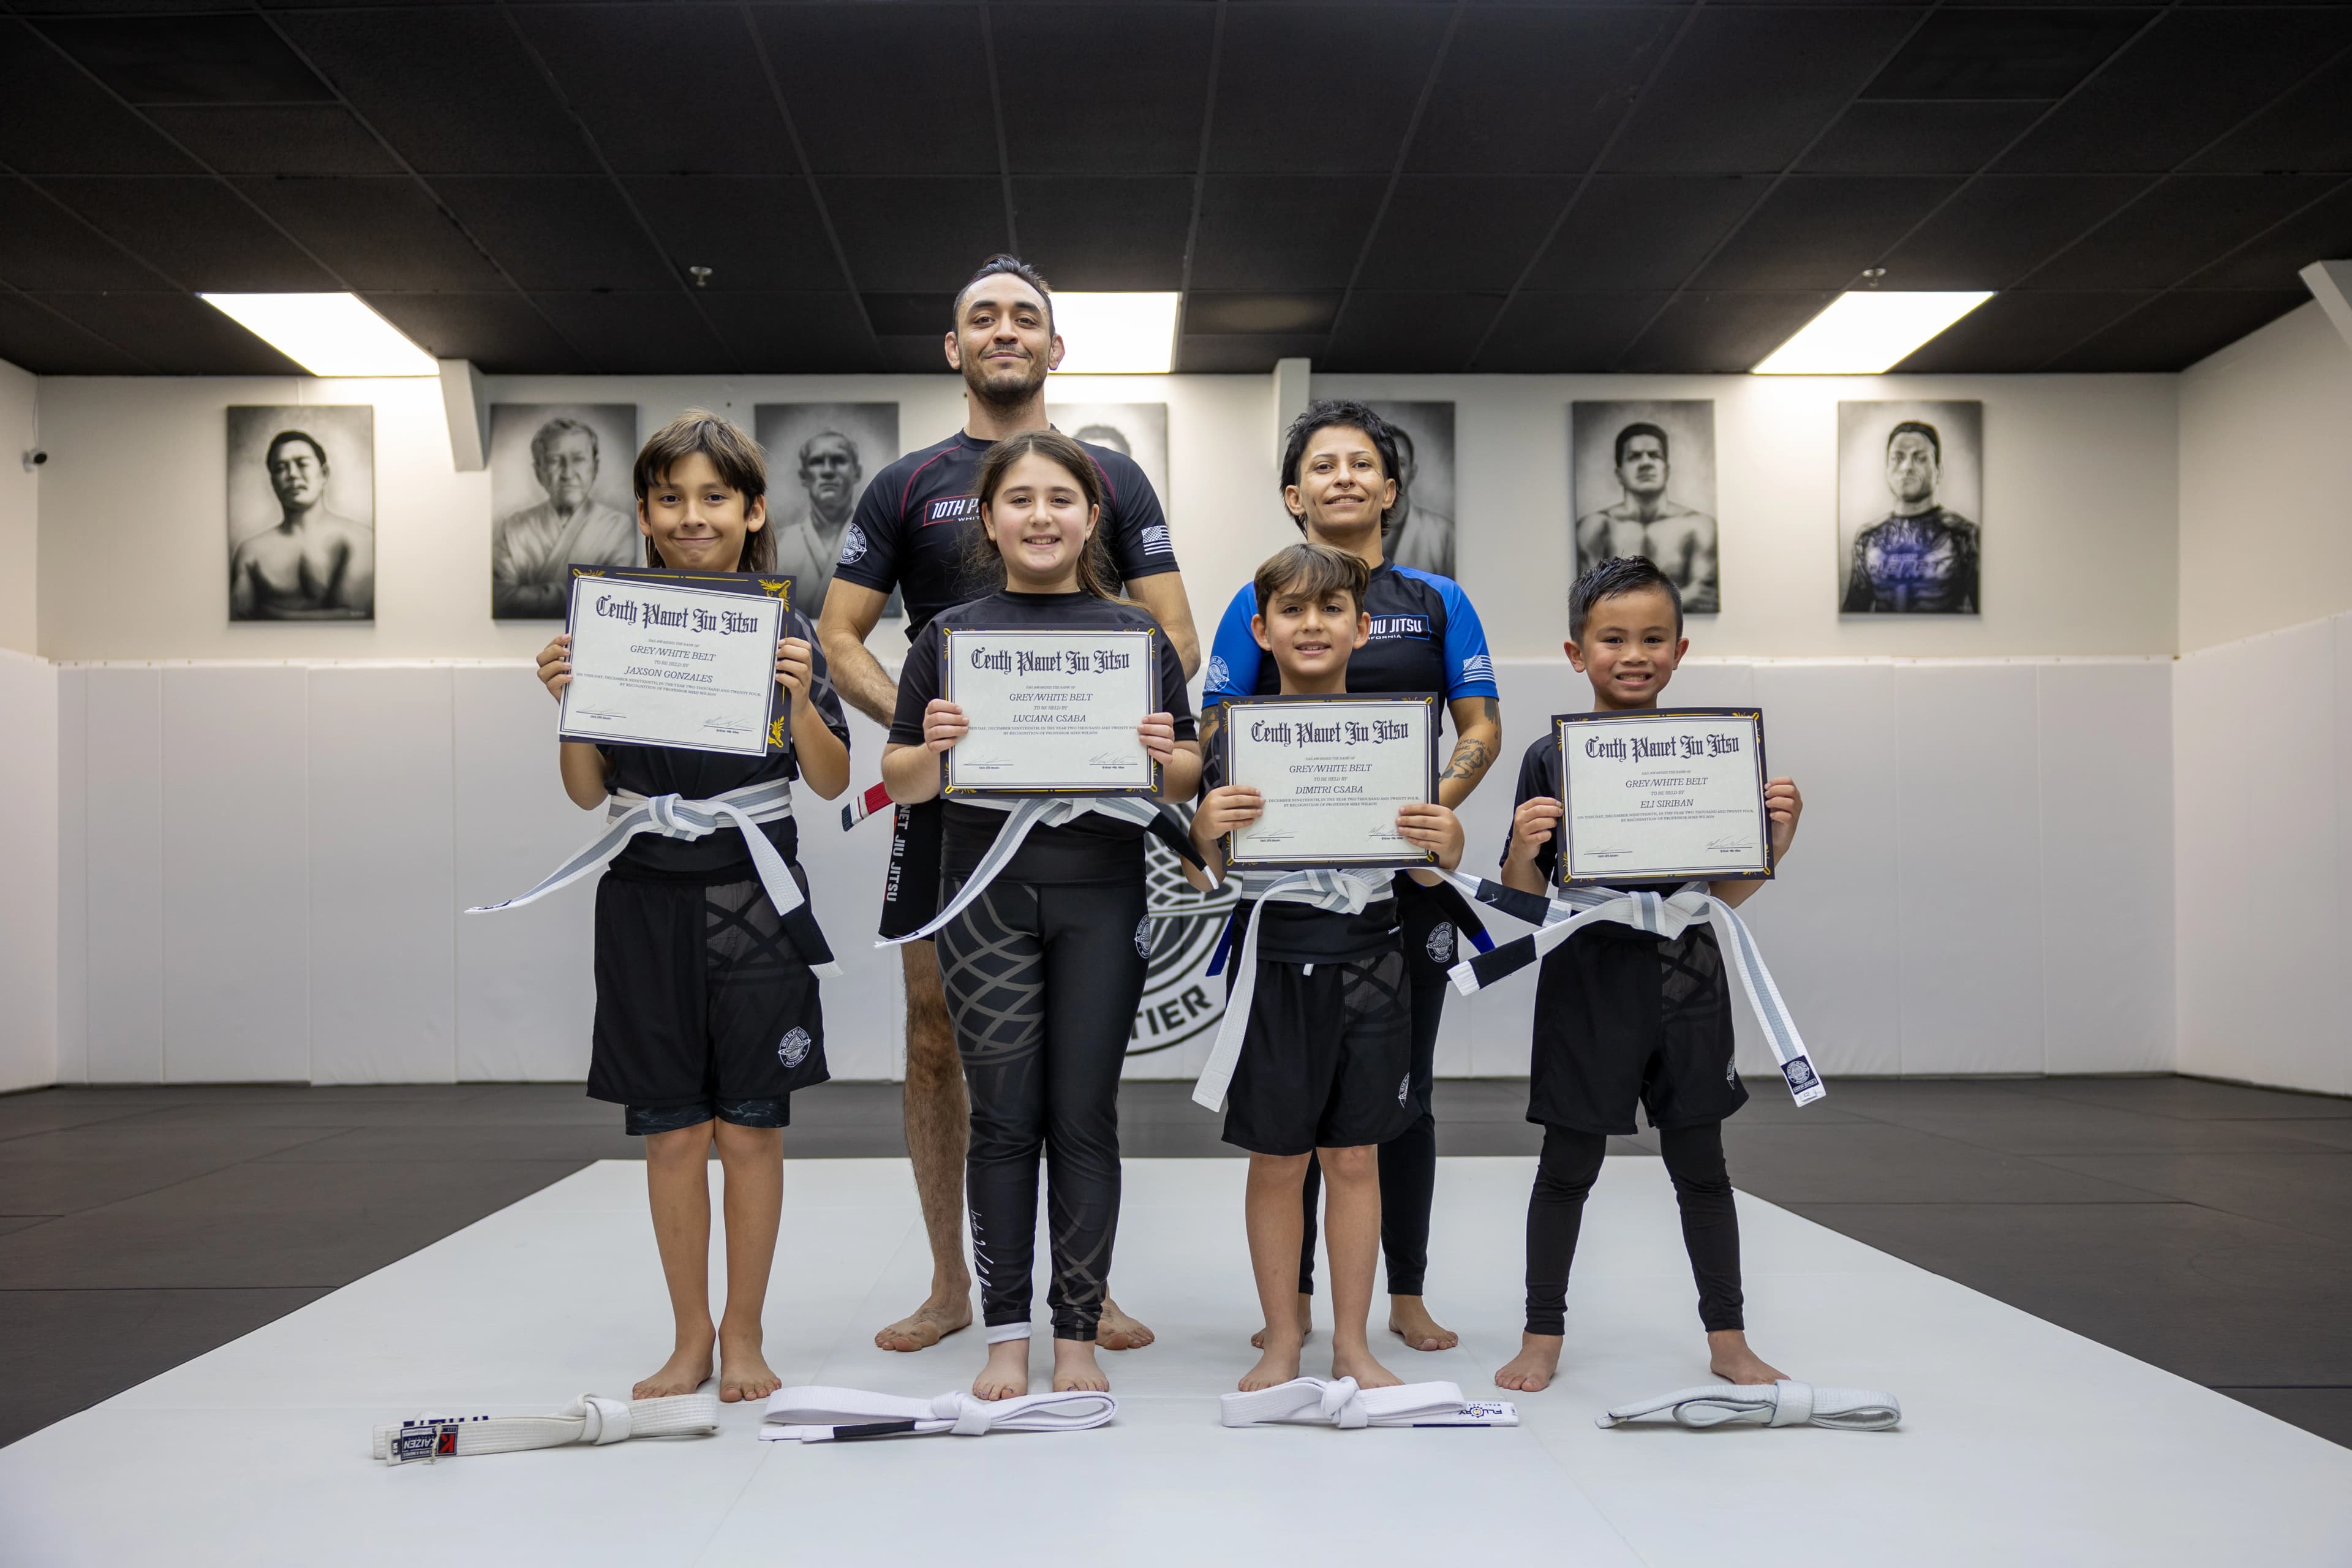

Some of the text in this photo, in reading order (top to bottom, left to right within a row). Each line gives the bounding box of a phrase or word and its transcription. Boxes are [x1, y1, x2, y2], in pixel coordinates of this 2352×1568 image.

[932, 500, 966, 519] 10TH
[641, 602, 688, 628] Planet
[690, 608, 717, 633] Jiu
[719, 611, 758, 635] Jitsu
[1389, 619, 1422, 633] JITSU
[630, 644, 716, 661] GREY/WHITE BELT
[1015, 650, 1061, 676] Planet
[1065, 650, 1090, 674] Jiu
[1093, 649, 1129, 674] Jitsu
[624, 666, 712, 682] JAXSON GONZALES
[1294, 722, 1341, 748] Planet
[1344, 721, 1369, 745] Jiu
[1372, 719, 1408, 744] Jitsu
[1629, 736, 1676, 763] Planet
[1679, 735, 1703, 759] Jiu
[1706, 733, 1739, 757] Jitsu
[1625, 778, 1684, 788] GREY/WHITE
[1656, 799, 1693, 807] SIRIBAN
[892, 835, 905, 857] JIU
[886, 862, 901, 902] JITSU
